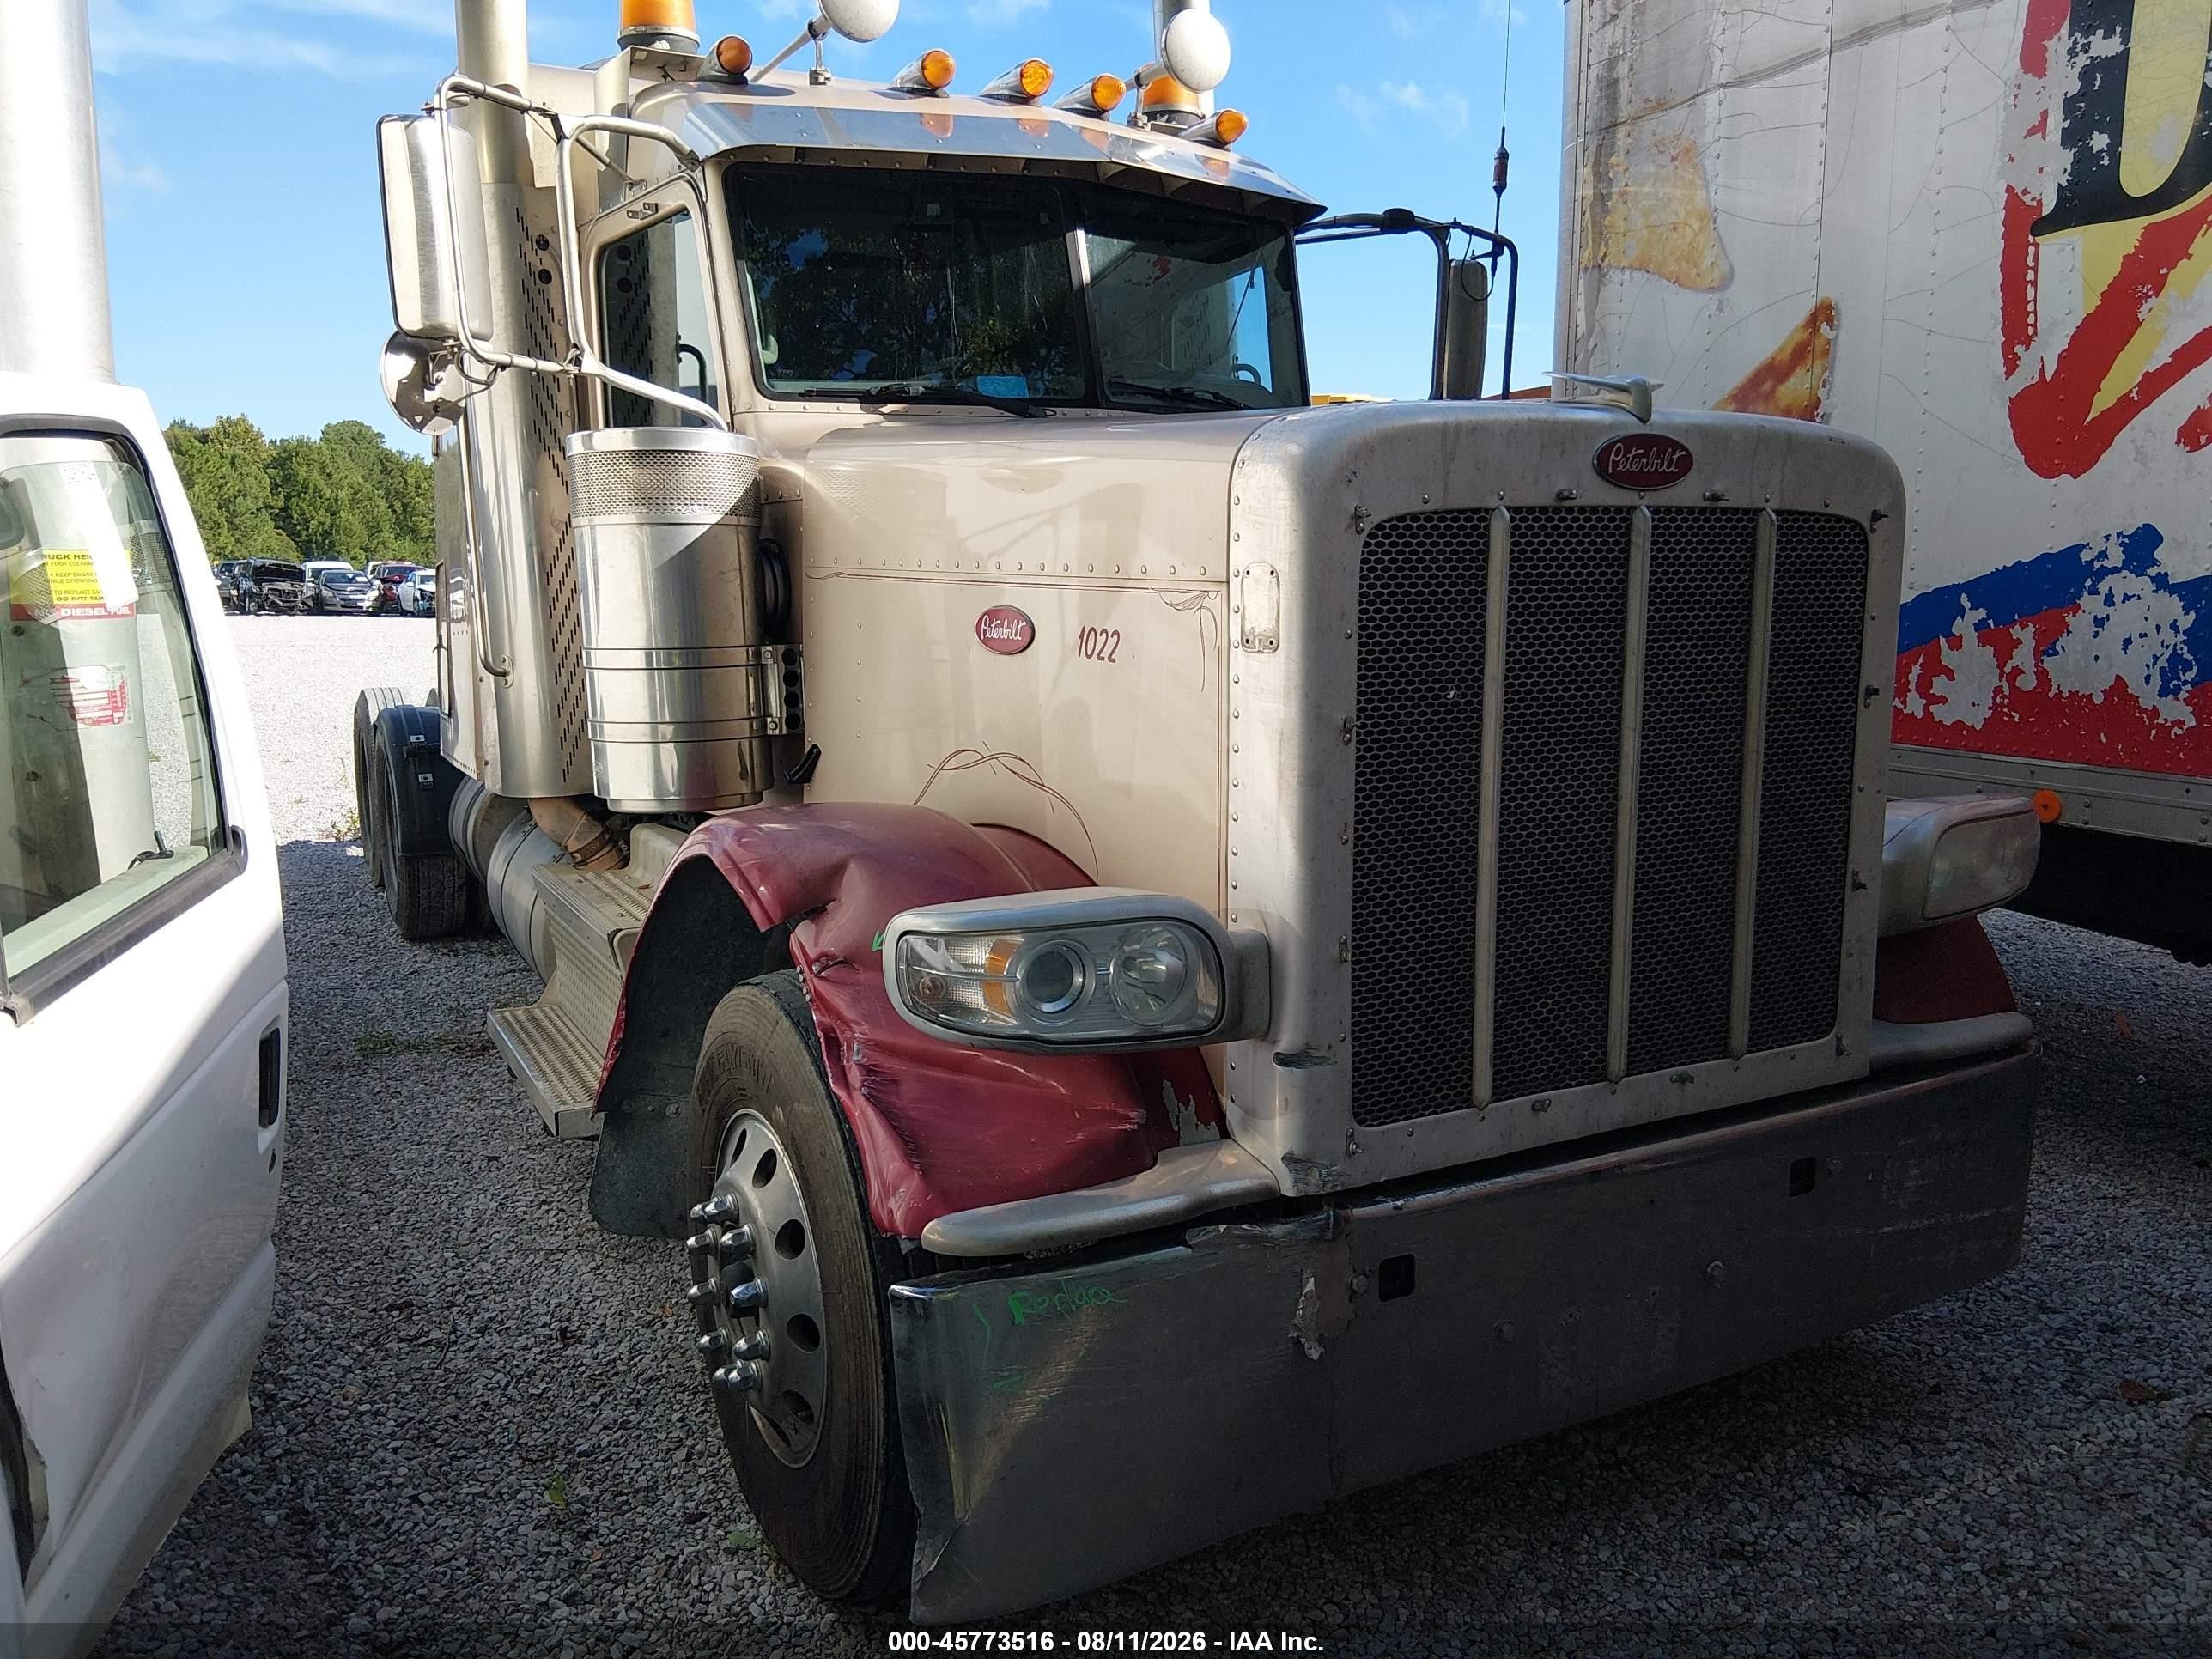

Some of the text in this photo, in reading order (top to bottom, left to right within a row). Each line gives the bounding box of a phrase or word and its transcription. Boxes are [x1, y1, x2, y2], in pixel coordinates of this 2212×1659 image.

[1608, 442, 1686, 474] Peterbilt
[60, 607, 108, 617] DIESEL
[981, 614, 1027, 641] Peterbilt
[1078, 625, 1121, 663] 1022
